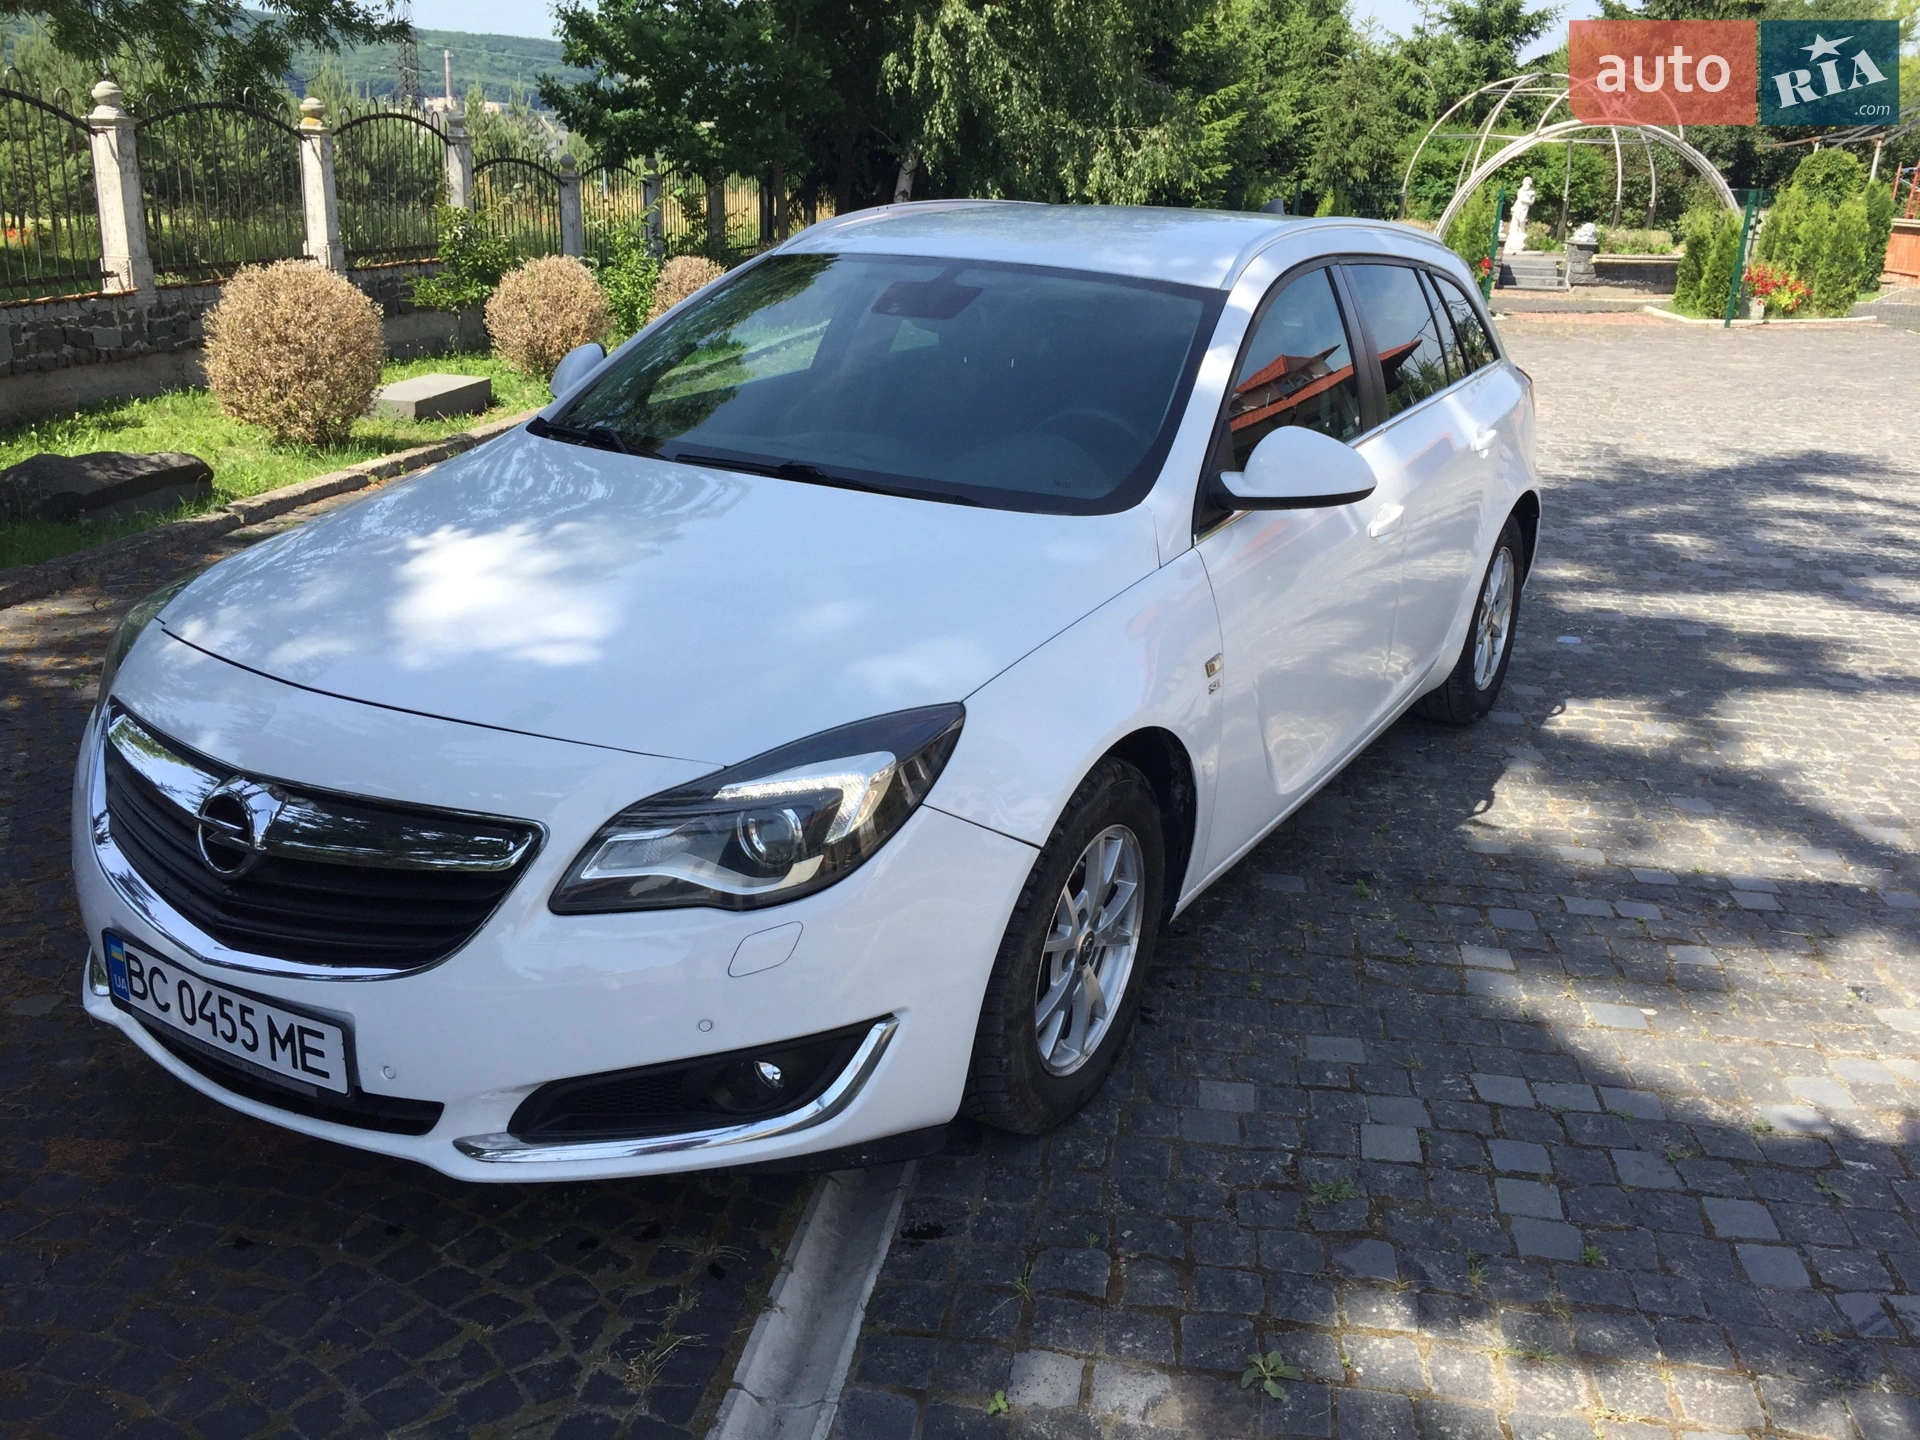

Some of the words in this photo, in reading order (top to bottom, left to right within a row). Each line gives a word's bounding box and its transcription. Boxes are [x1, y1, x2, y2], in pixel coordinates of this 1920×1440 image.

[113, 973, 129, 992] UA
[124, 950, 171, 1013] BC
[177, 979, 260, 1053] 0455
[266, 1014, 331, 1080] ME
